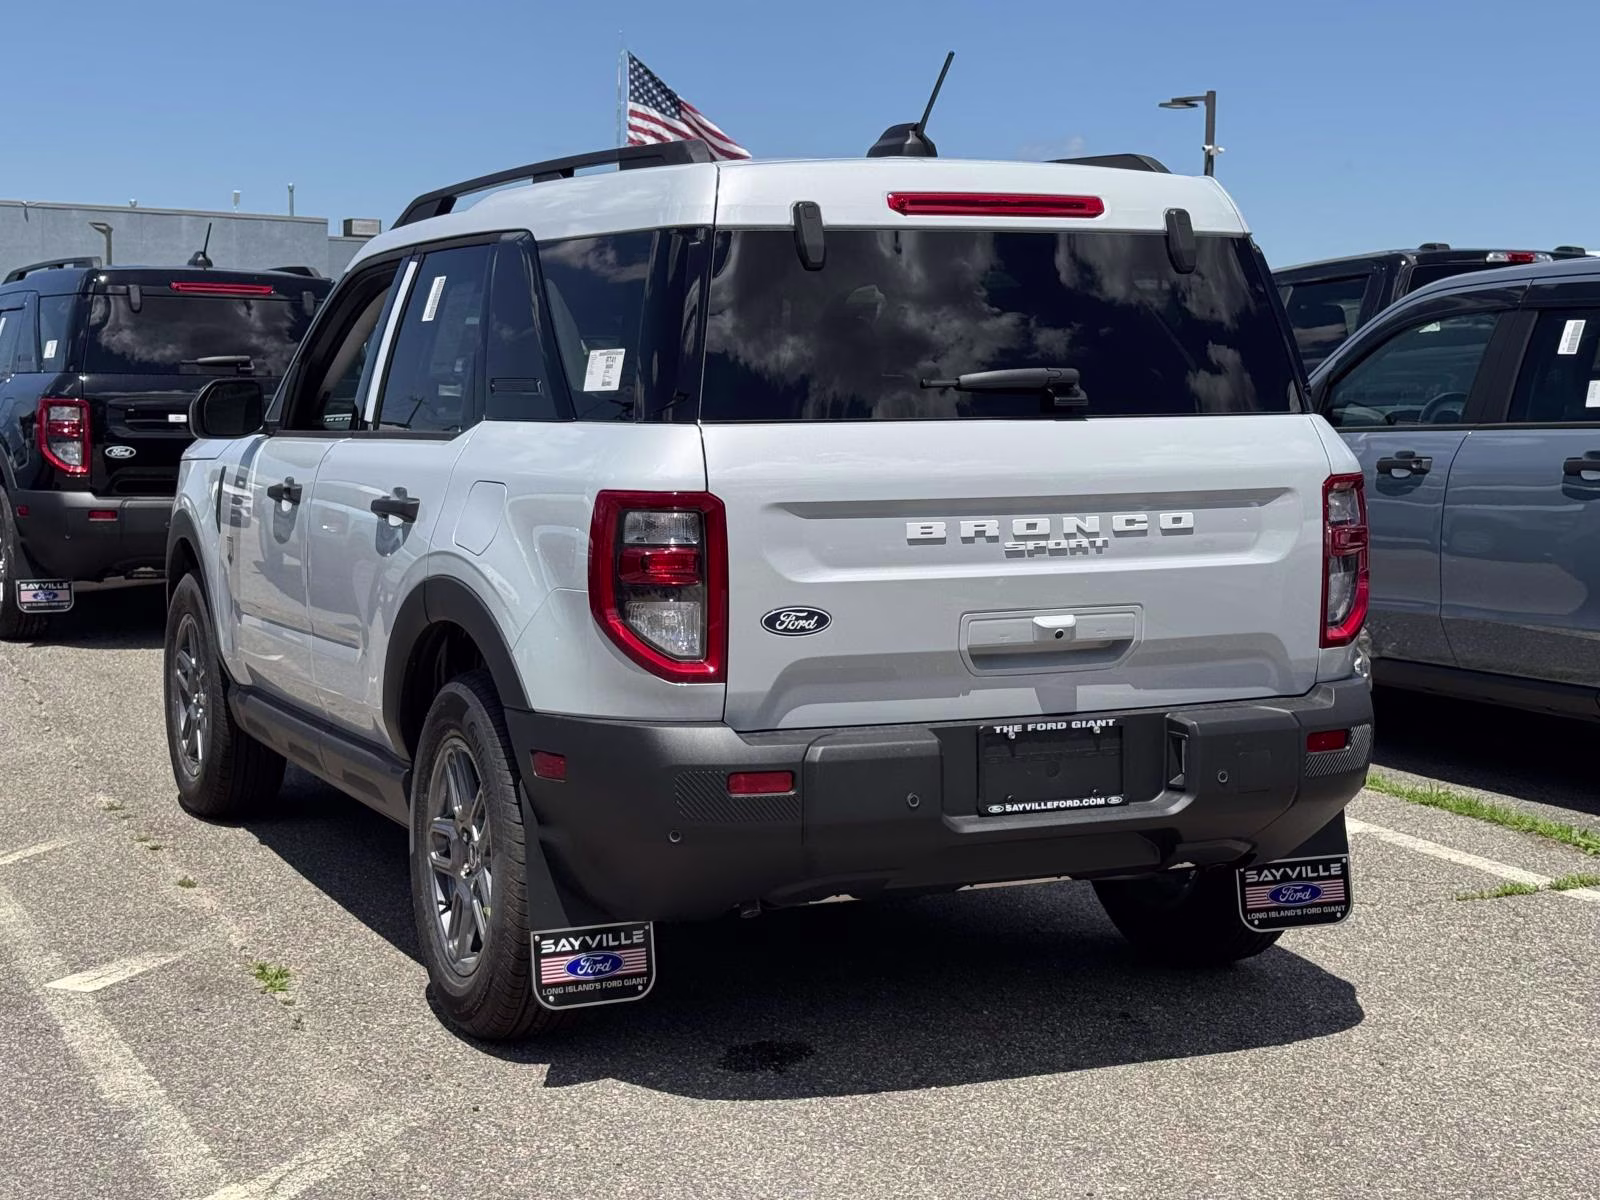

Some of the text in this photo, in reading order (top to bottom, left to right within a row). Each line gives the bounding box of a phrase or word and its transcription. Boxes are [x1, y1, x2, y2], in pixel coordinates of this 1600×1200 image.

[906, 512, 1194, 545] BRONCO
[1004, 537, 1109, 558] SPORT
[775, 611, 818, 630] Ford
[993, 718, 1116, 734] THE FORD GIANT
[1005, 797, 1105, 812] SAYVILLEFORD.COM
[1245, 863, 1342, 883] SAYVILLE
[1279, 886, 1312, 902] Ford
[1247, 904, 1346, 920] LONG ISLAND'S FORD GIANT
[541, 930, 645, 954] SAYVILLE
[577, 956, 613, 975] Ford
[542, 976, 648, 996] LONG ISLAND'S FORD GIANT
